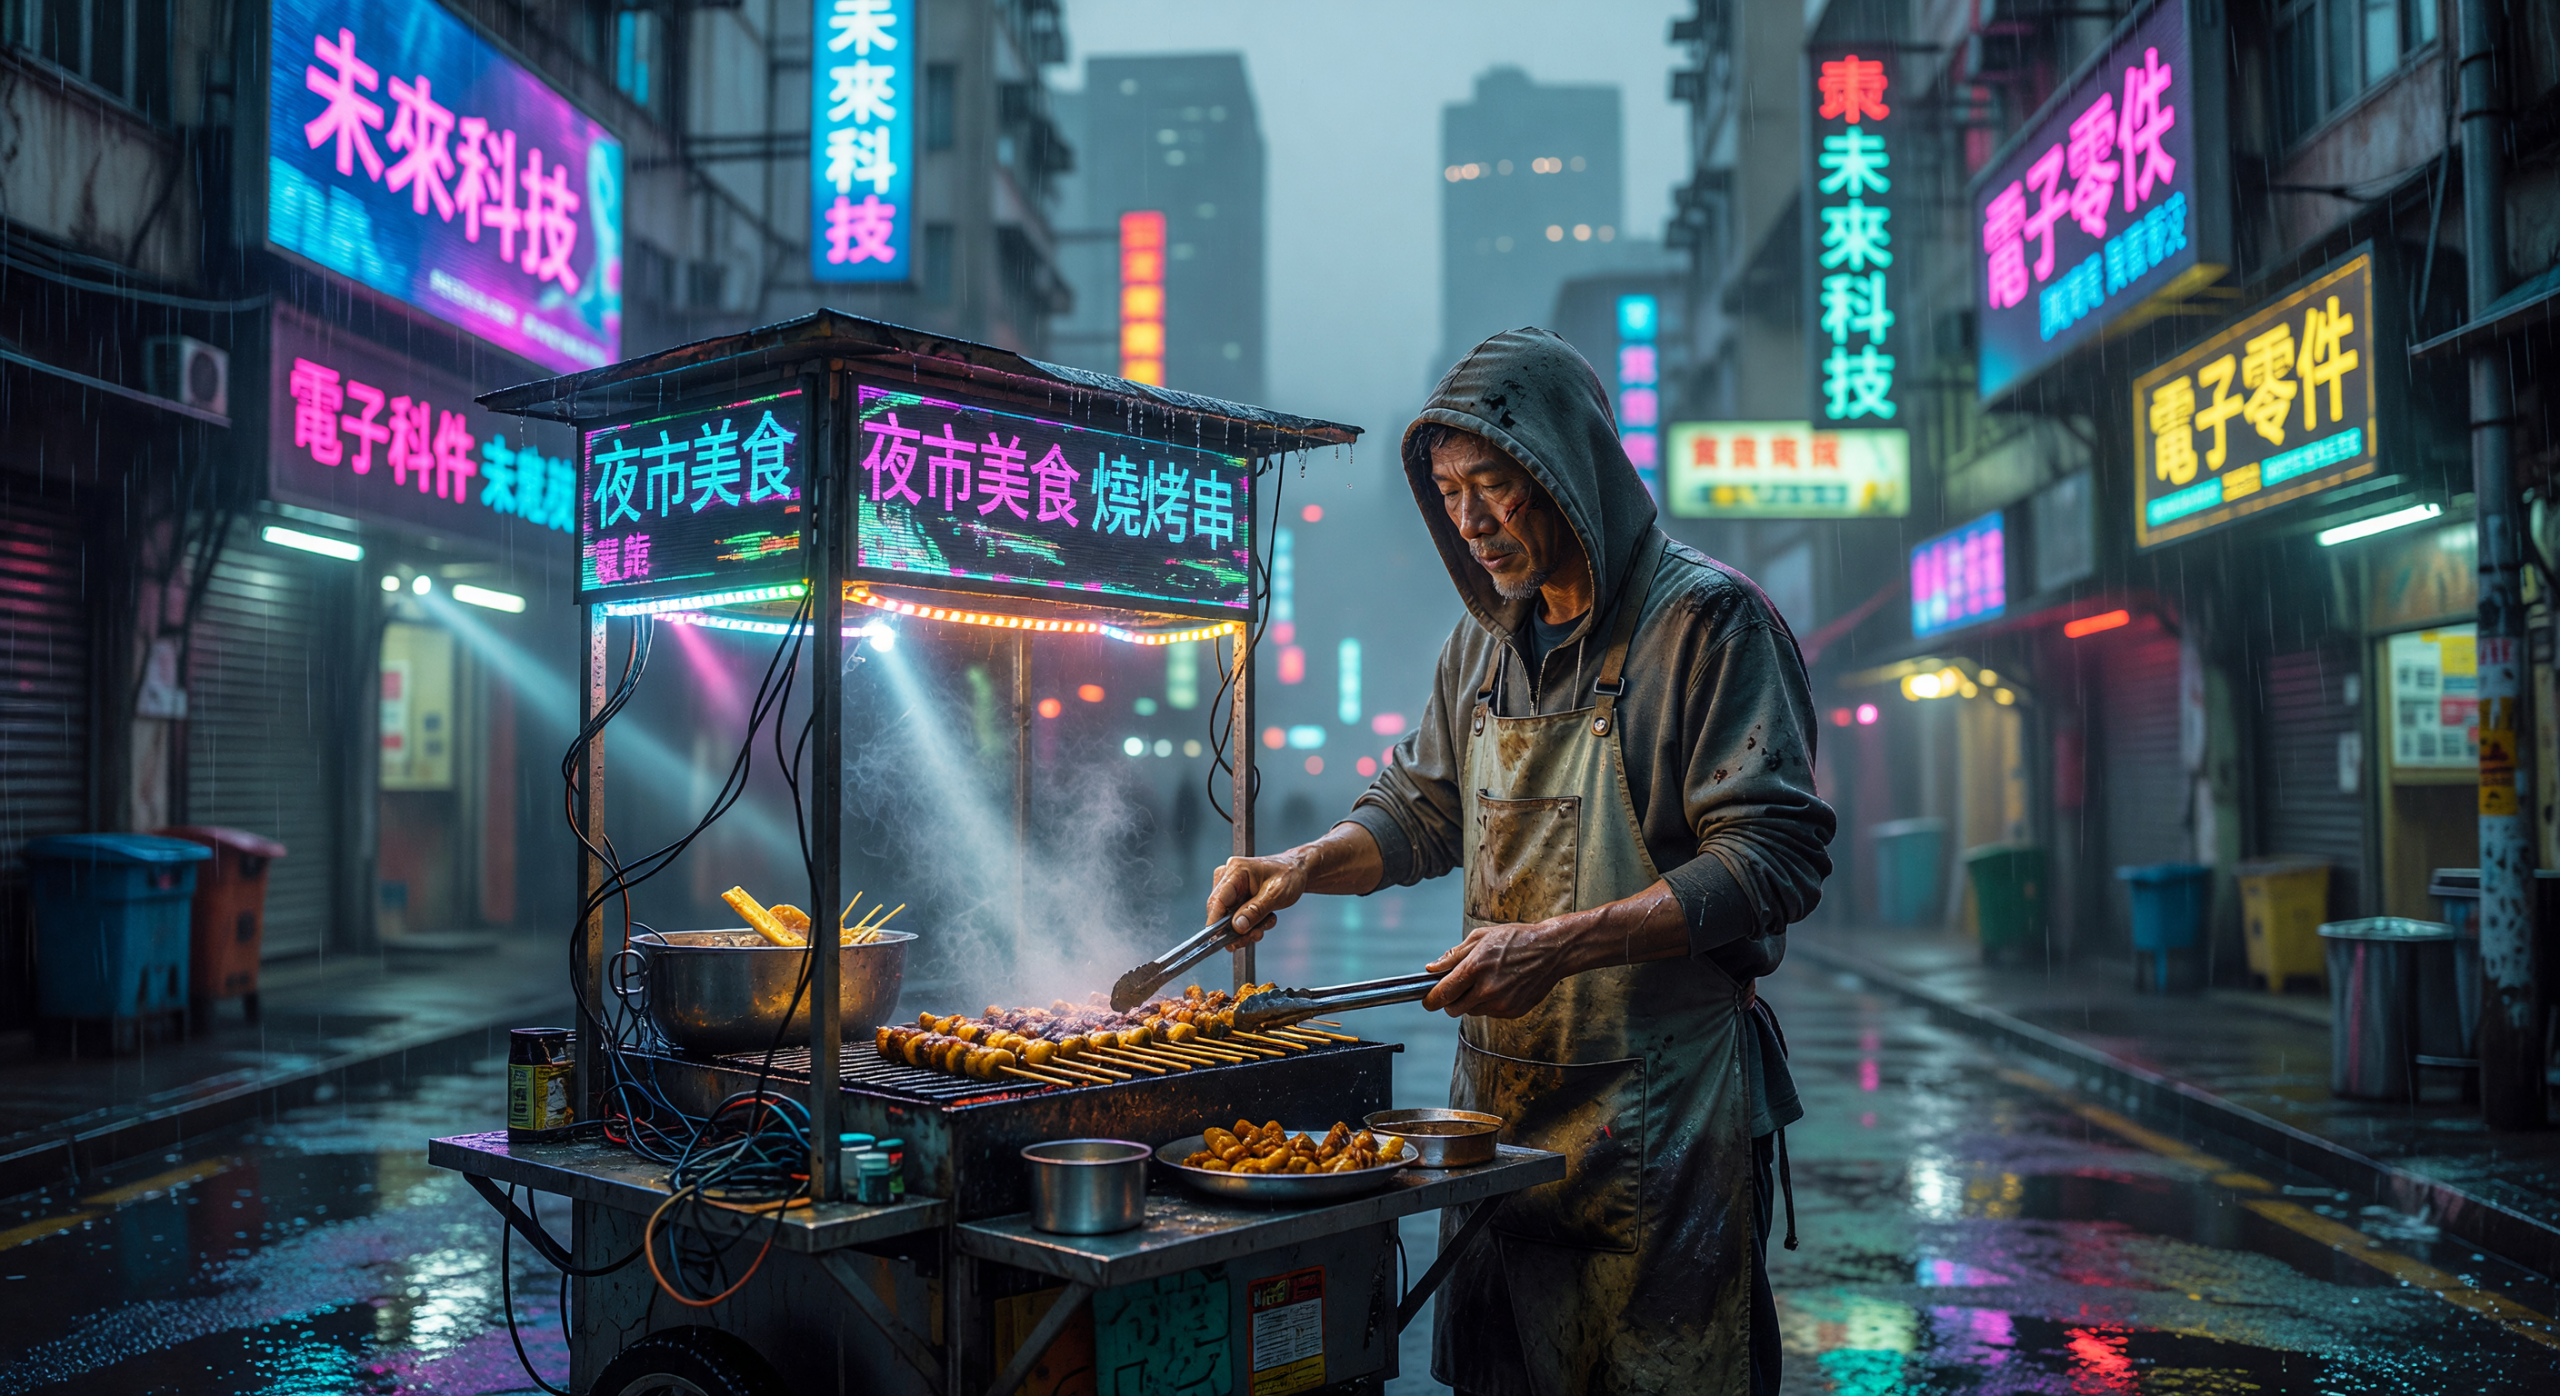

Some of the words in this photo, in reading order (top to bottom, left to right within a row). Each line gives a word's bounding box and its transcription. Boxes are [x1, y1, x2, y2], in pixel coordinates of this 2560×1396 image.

[304, 27, 581, 295] 未來科技
[825, 0, 898, 265] 未來科技
[290, 357, 478, 504] 電子科件
[593, 410, 797, 529] 夜市美食
[2149, 295, 2359, 486] 電子零件
[862, 412, 1081, 528] 夜市美食
[1091, 451, 1234, 551] 燒烤串
